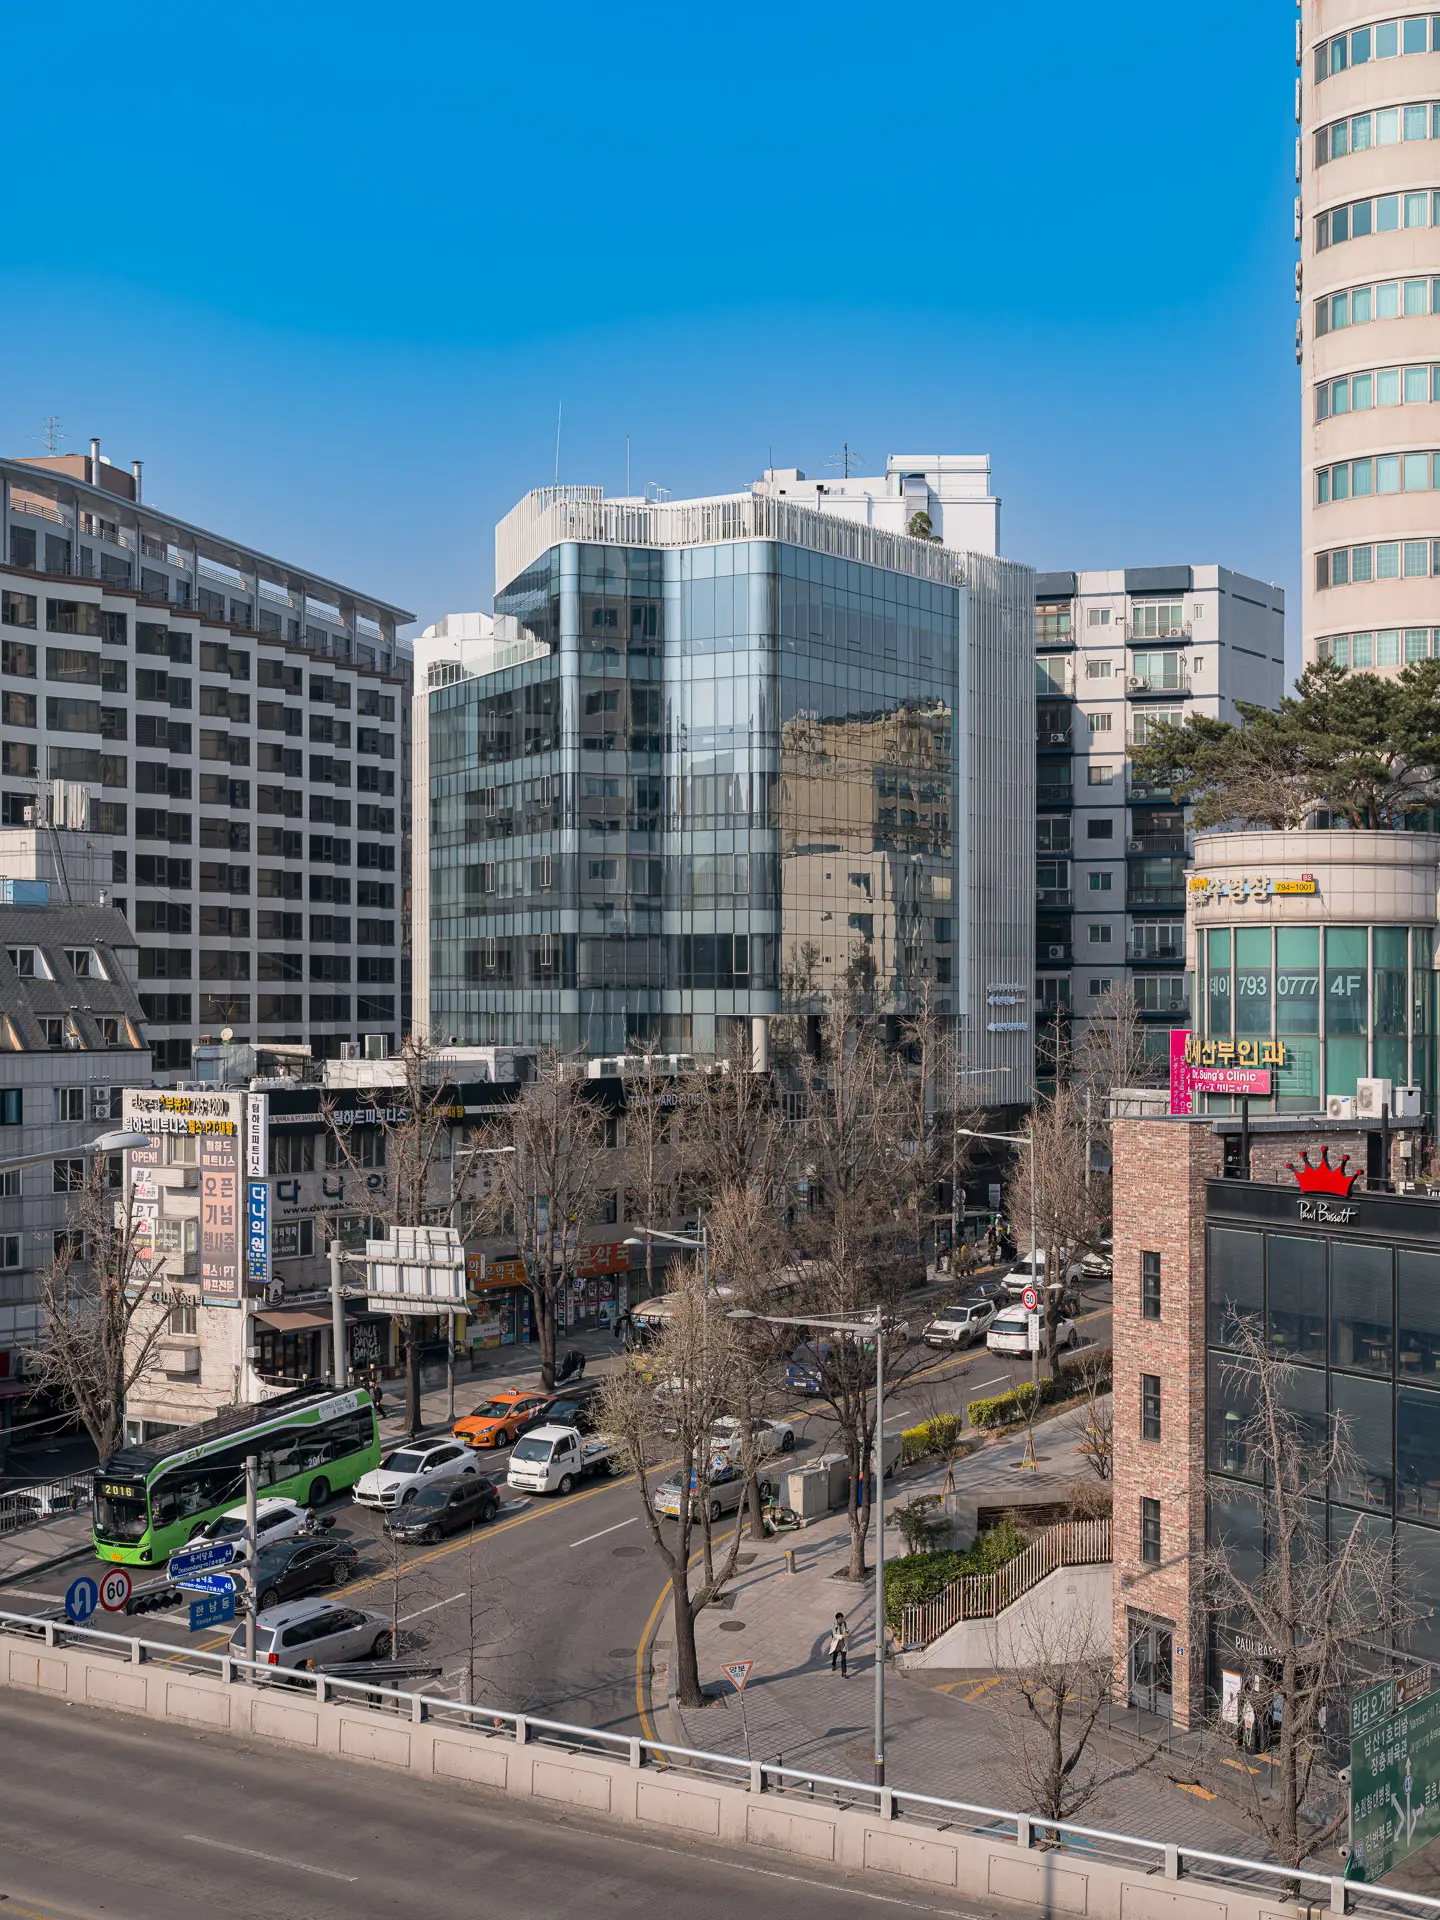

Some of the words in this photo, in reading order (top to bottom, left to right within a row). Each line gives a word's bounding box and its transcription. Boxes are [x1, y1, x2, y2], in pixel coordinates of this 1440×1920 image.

[1208, 874, 1269, 901] 수영장
[1276, 883, 1313, 891] 794-1001
[1238, 976, 1267, 996] 793
[1277, 976, 1318, 996] 0777
[1330, 975, 1361, 996] 4F
[1192, 1069, 1224, 1082] Dr.Sung's
[1226, 1071, 1257, 1082] Clinic
[165, 1097, 191, 1113] 부동산
[206, 1140, 231, 1152] 팀하드
[252, 1103, 260, 1175] 팀하드피트니스
[132, 1151, 157, 1163] OPEN!
[202, 1154, 236, 1167] 피트니스
[205, 1177, 233, 1198] 오픈
[205, 1204, 232, 1226] 기념
[251, 1186, 266, 1253] 다나의원
[1296, 1200, 1317, 1221] Paul
[204, 1231, 235, 1253] 행사중
[202, 1263, 218, 1277] 헬스
[224, 1265, 235, 1278] PT
[469, 1261, 479, 1278] 약
[1026, 1294, 1034, 1304] 50
[353, 1323, 377, 1337] DANCE
[354, 1336, 379, 1348] DANCE
[186, 1447, 205, 1461] EV
[105, 1484, 132, 1497] 2016
[190, 1550, 213, 1563] 독서당로
[107, 1579, 125, 1600] 60
[196, 1597, 229, 1617] 한남동
[1235, 1635, 1256, 1653] PAUL
[728, 1665, 746, 1673] 양보
[1353, 1681, 1394, 1729] 한남오거리
[1364, 1715, 1408, 1758] 남산1호터널
[1371, 1738, 1408, 1777] 장충체육관
[1354, 1782, 1391, 1822] 순천향대병원
[1365, 1820, 1393, 1853] 강변북로
